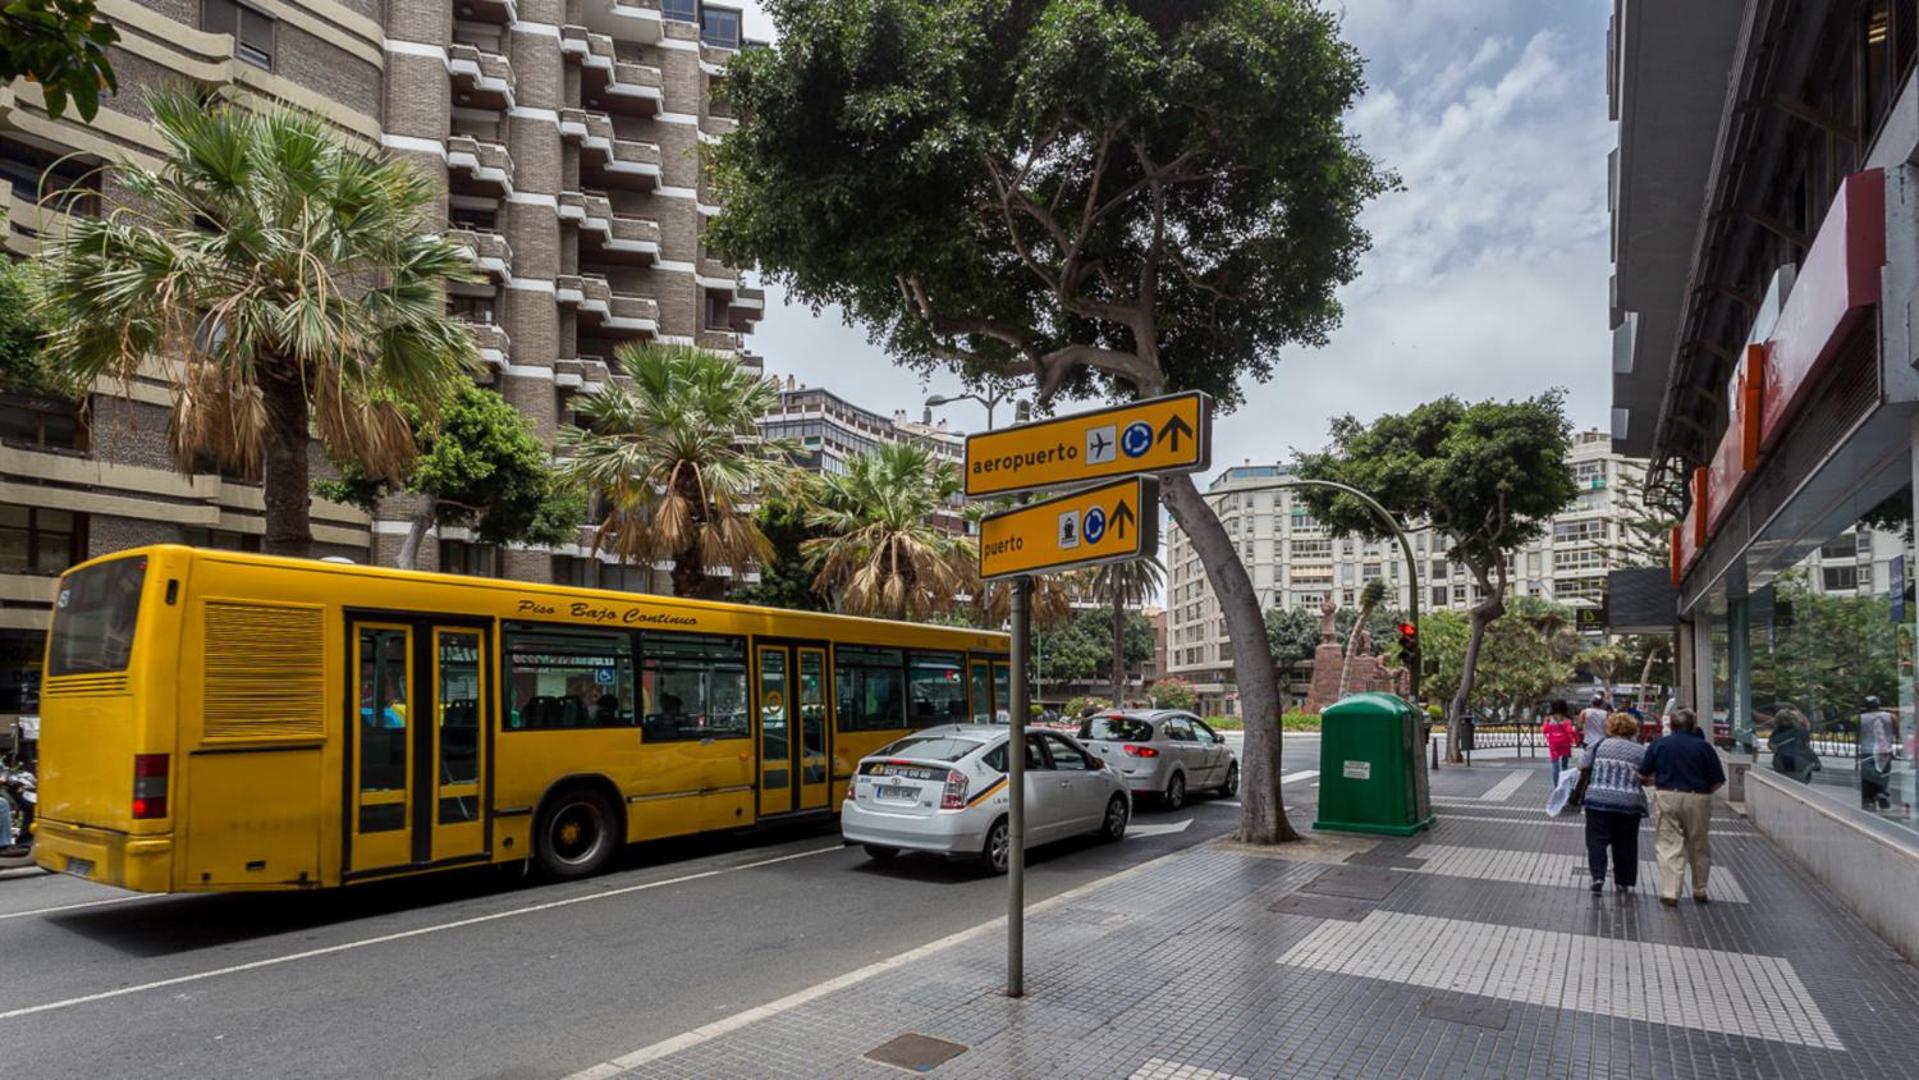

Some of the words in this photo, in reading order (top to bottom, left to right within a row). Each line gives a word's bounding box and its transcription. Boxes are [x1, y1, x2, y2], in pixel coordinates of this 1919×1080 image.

[973, 443, 1078, 474] aeropuerto
[984, 534, 1023, 559] puerto
[517, 600, 556, 615] Piso
[570, 602, 617, 622] Bajo
[622, 608, 698, 626] Continuo
